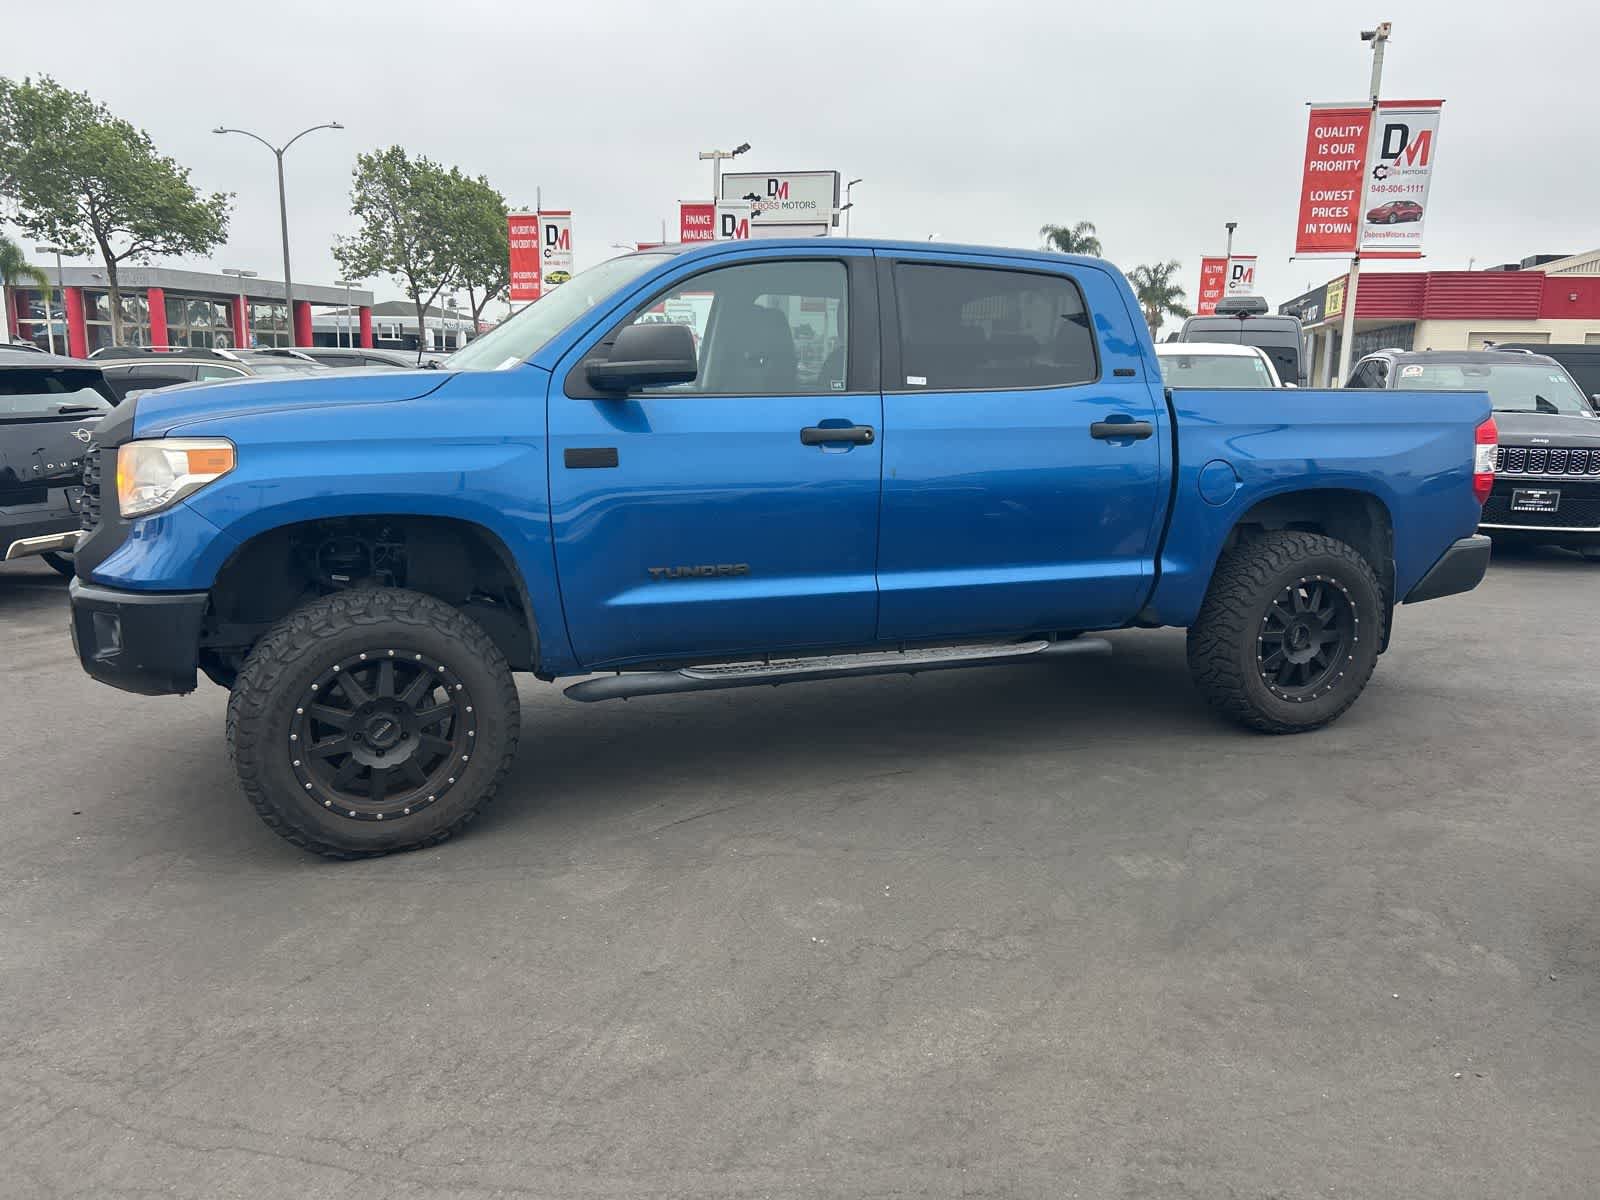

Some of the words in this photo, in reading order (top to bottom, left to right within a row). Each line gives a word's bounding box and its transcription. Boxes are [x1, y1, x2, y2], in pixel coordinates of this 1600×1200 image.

[1315, 126, 1364, 138] QUALITY
[1318, 143, 1330, 155] IS
[1330, 143, 1355, 155] OUR
[1381, 123, 1433, 167] DM
[1309, 159, 1361, 172] PRIORITY
[1371, 184, 1424, 193] 949-506-1111
[1310, 190, 1354, 202] LOWEST
[781, 200, 817, 210] MOTORS
[1311, 206, 1349, 218] PRICES
[685, 215, 711, 225] FINANCE
[1304, 223, 1317, 234] IN
[1318, 223, 1352, 234] TOWN
[647, 563, 750, 578] TUNDRA
